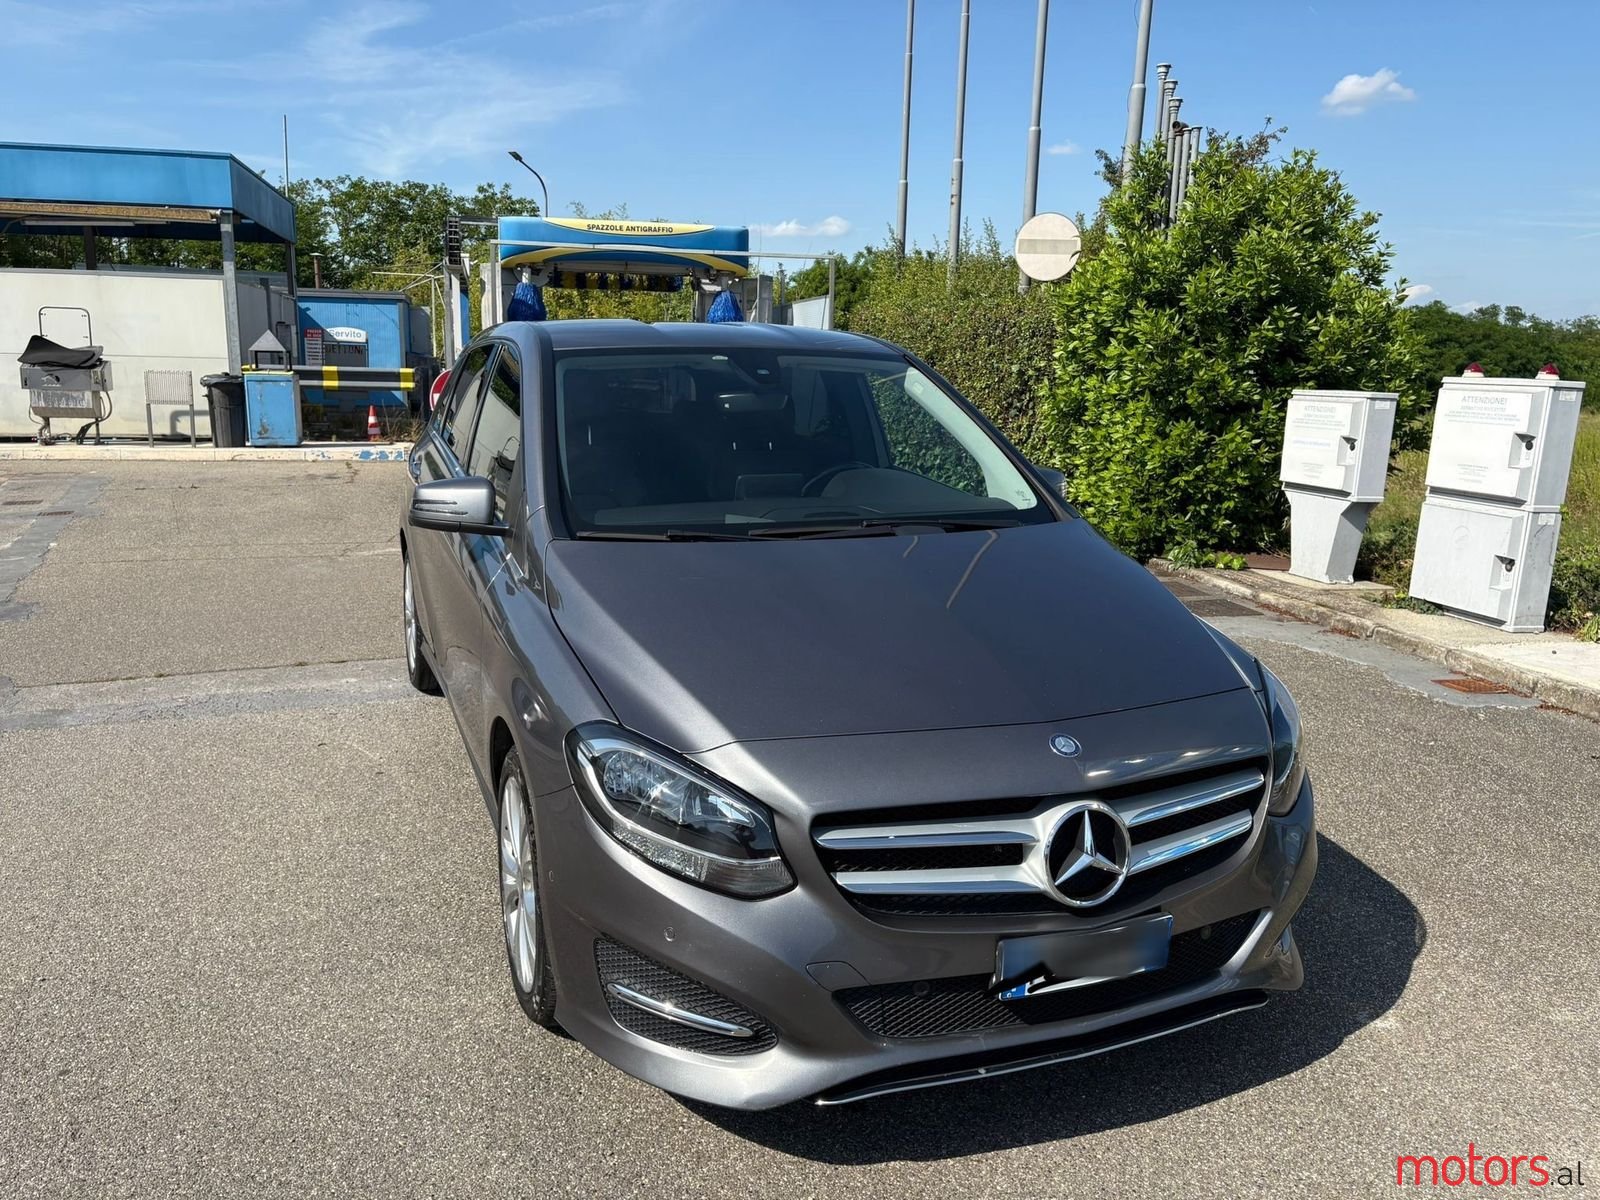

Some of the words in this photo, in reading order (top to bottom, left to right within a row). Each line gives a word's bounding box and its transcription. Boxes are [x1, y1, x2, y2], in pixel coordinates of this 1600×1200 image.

[586, 223, 624, 232] SPAZZOLE
[625, 225, 674, 233] ANTIGRAFFIO
[1461, 395, 1508, 405] ATTENZIONE!
